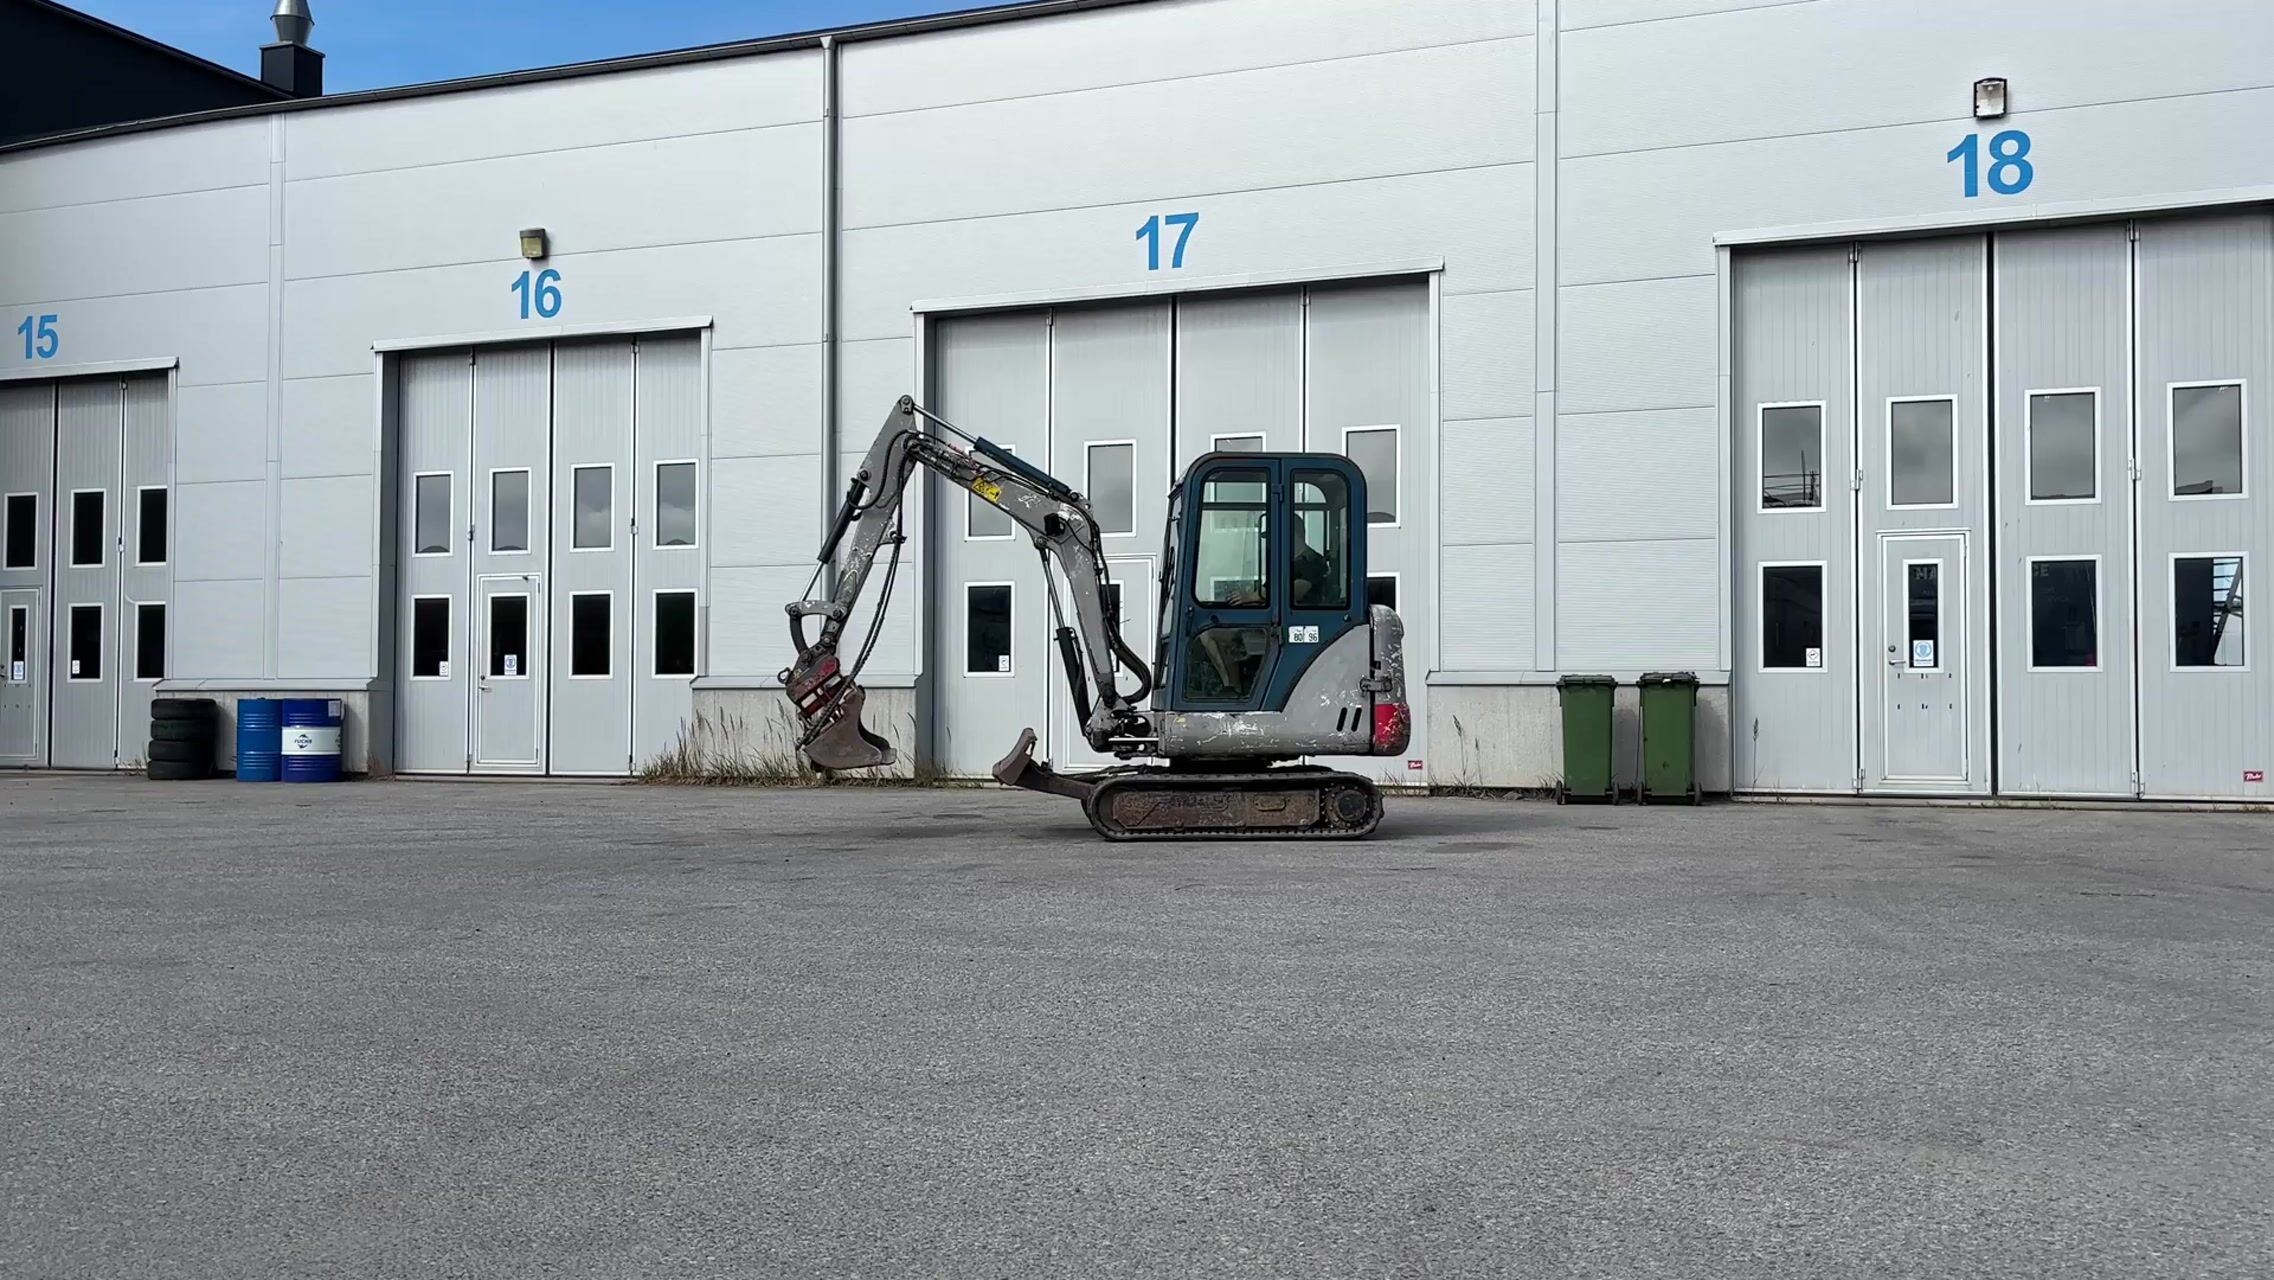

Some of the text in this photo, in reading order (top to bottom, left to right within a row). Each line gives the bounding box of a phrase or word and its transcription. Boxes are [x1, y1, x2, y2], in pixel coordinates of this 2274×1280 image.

[1947, 130, 2035, 198] 18
[1135, 212, 1200, 272] 17
[511, 268, 563, 319] 16
[18, 314, 60, 360] 15
